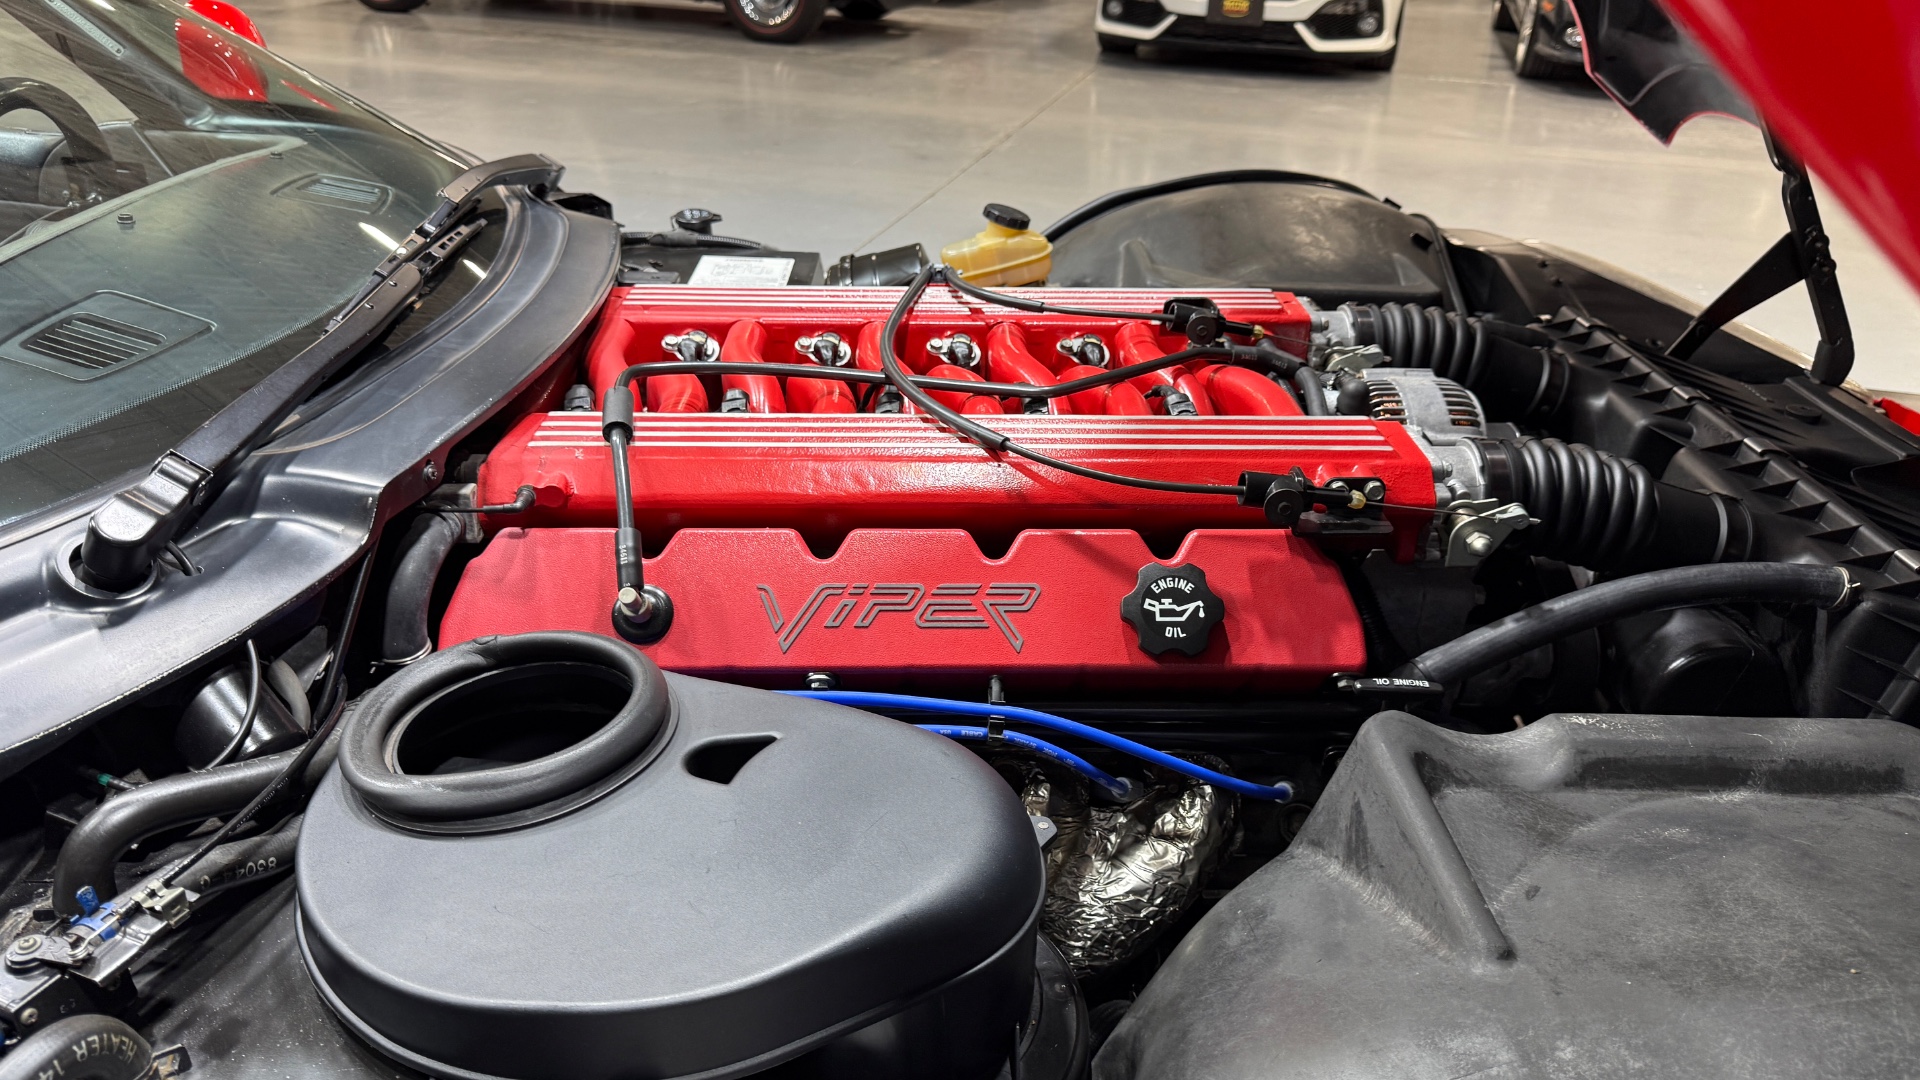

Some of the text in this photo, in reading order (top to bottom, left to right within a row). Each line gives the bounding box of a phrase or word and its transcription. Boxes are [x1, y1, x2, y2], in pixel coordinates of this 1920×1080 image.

[619, 544, 628, 565] 34611
[1150, 577, 1195, 594] ENGINE
[756, 583, 1041, 654] VIPER
[1165, 626, 1187, 638] OIL
[1372, 677, 1430, 688] ENGINE OIL
[960, 729, 984, 738] CABLE
[1013, 737, 1037, 748] SPARK
[72, 1033, 138, 1064] HEATER
